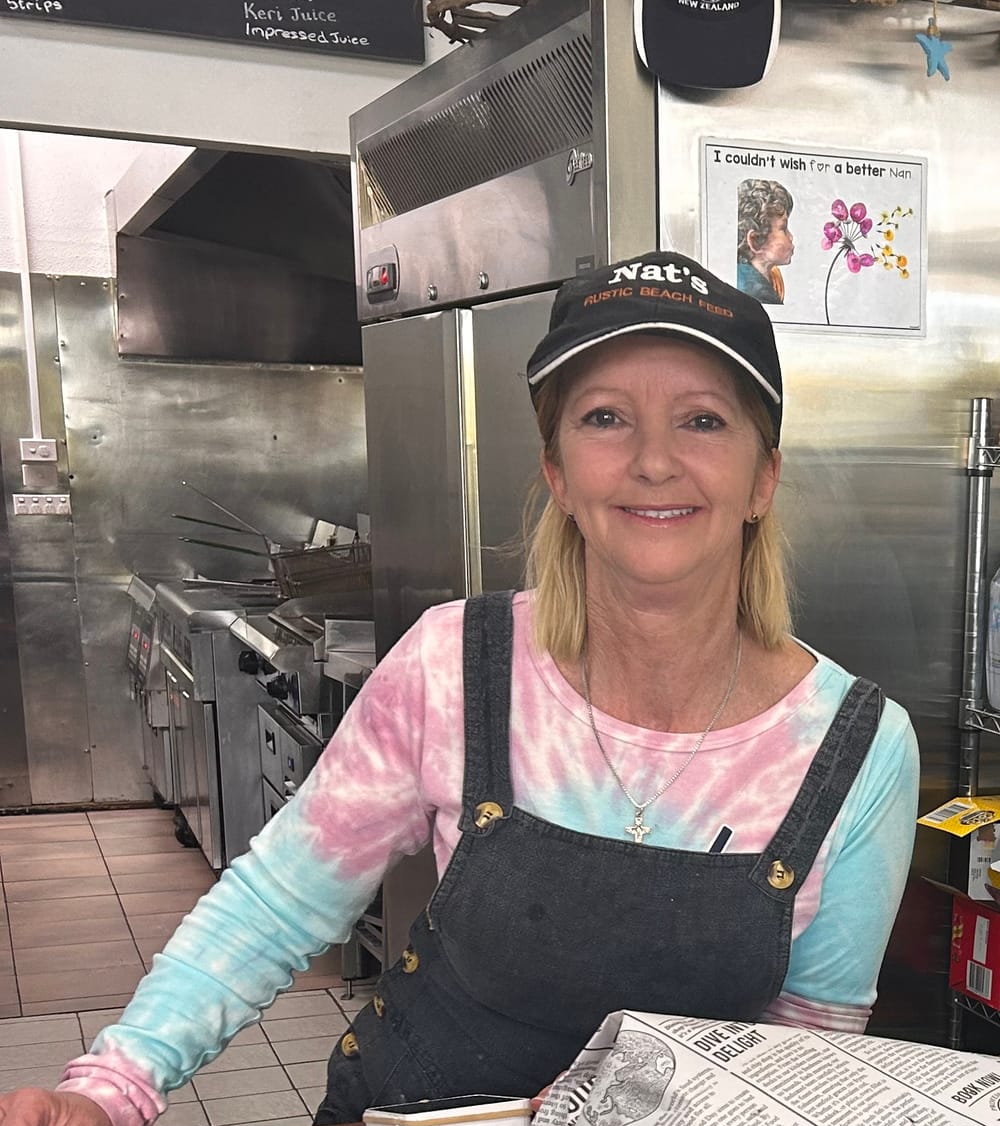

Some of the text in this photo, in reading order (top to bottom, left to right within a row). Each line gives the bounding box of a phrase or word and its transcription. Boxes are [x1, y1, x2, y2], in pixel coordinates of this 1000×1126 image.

[6, 0, 63, 13] Strips
[243, 2, 337, 23] Keri Juice
[700, 1, 740, 11] ZEALAND
[714, 150, 912, 179] I couldn't wish for a better Nan
[608, 262, 709, 295] Nat's
[583, 286, 734, 318] RUSTIC BEACH FEED
[694, 1026, 729, 1052] DIVE
[712, 1030, 767, 1064] DELIGHT
